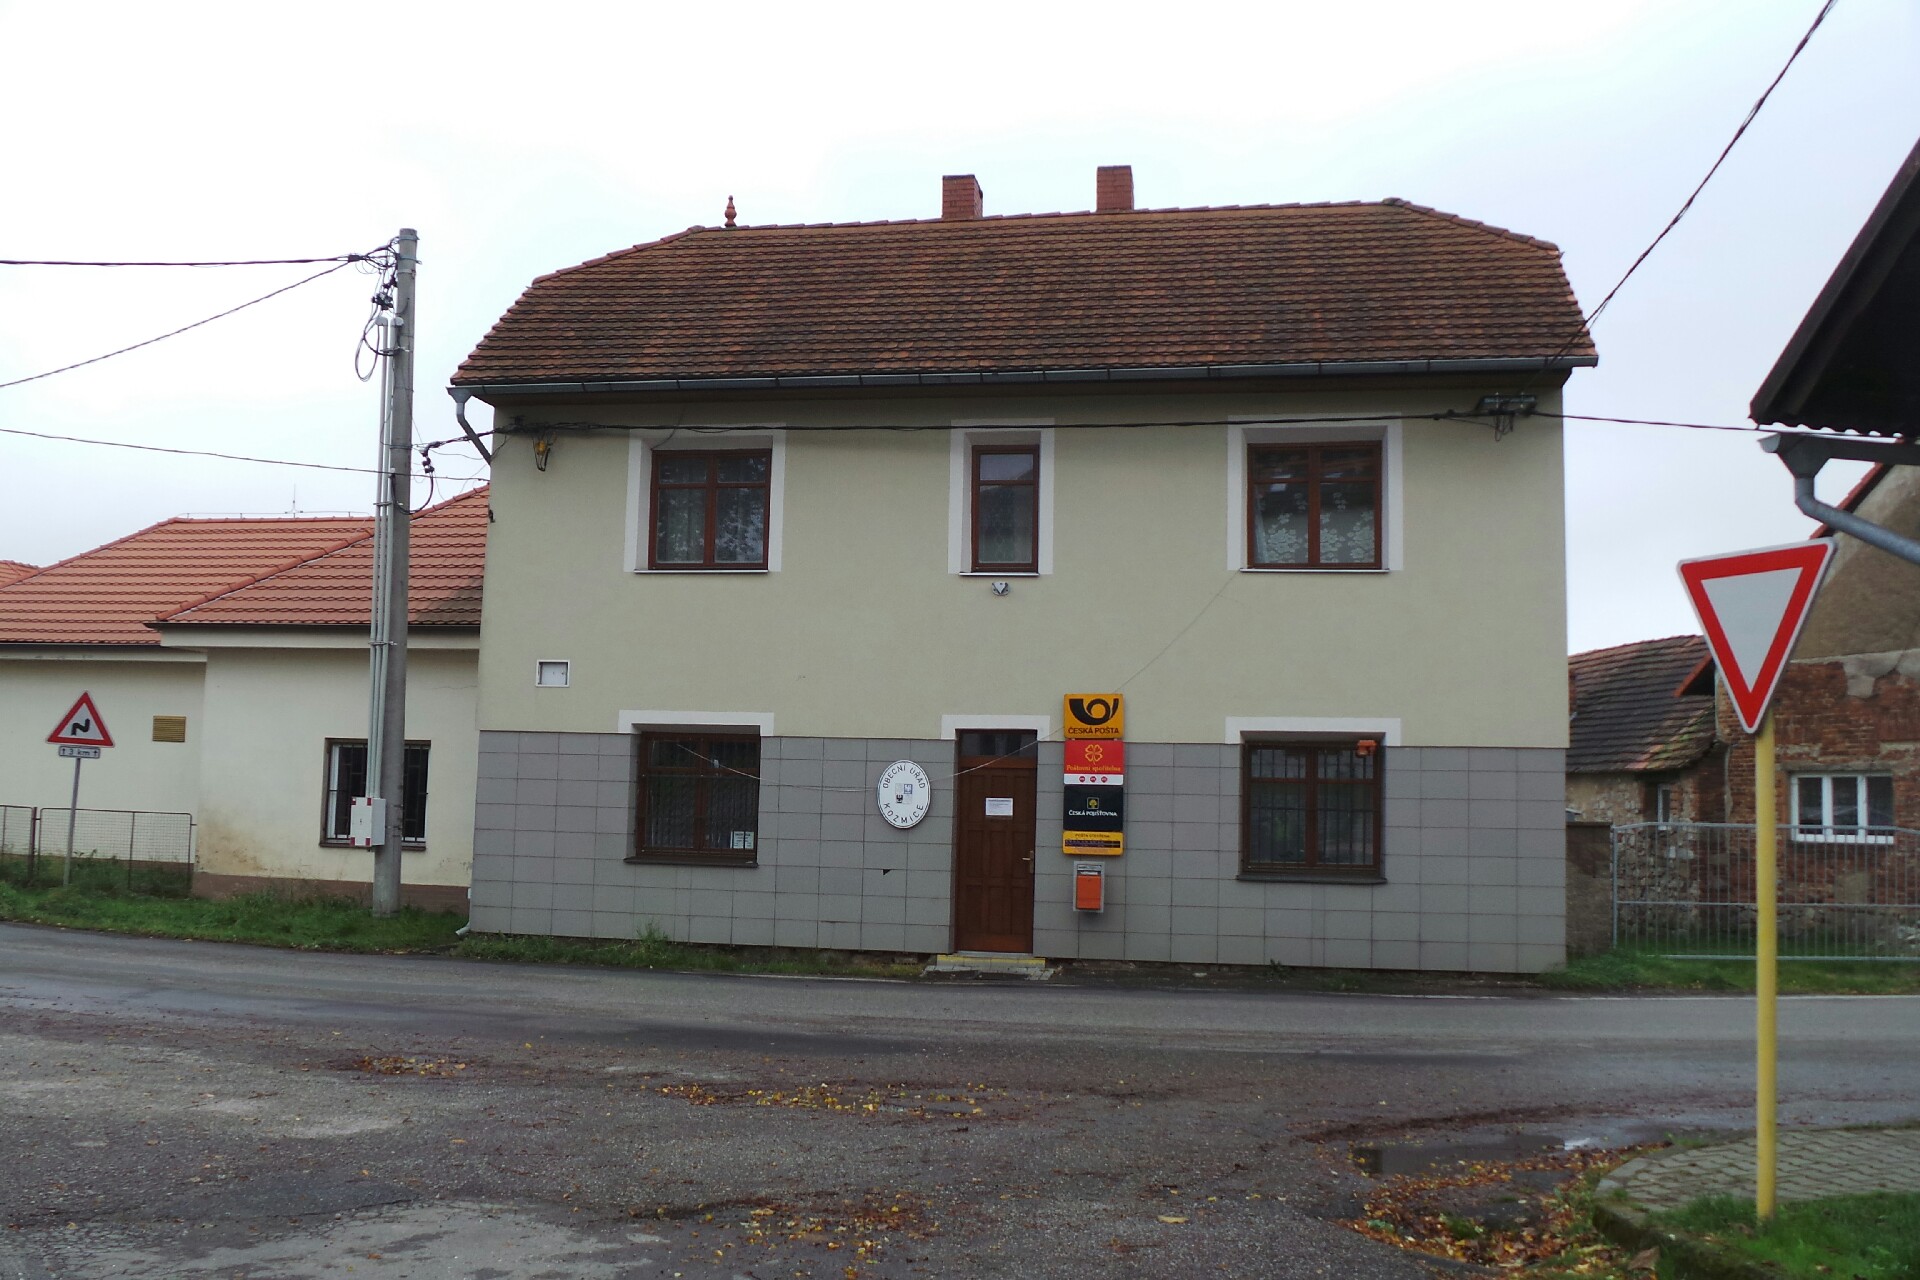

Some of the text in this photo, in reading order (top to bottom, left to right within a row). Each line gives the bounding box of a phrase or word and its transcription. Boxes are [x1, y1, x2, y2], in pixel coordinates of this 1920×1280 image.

[1068, 726, 1119, 734] ČESKÁ POŠTA
[883, 763, 906, 788] OBECNÍ
[883, 802, 923, 823] KOZMICE
